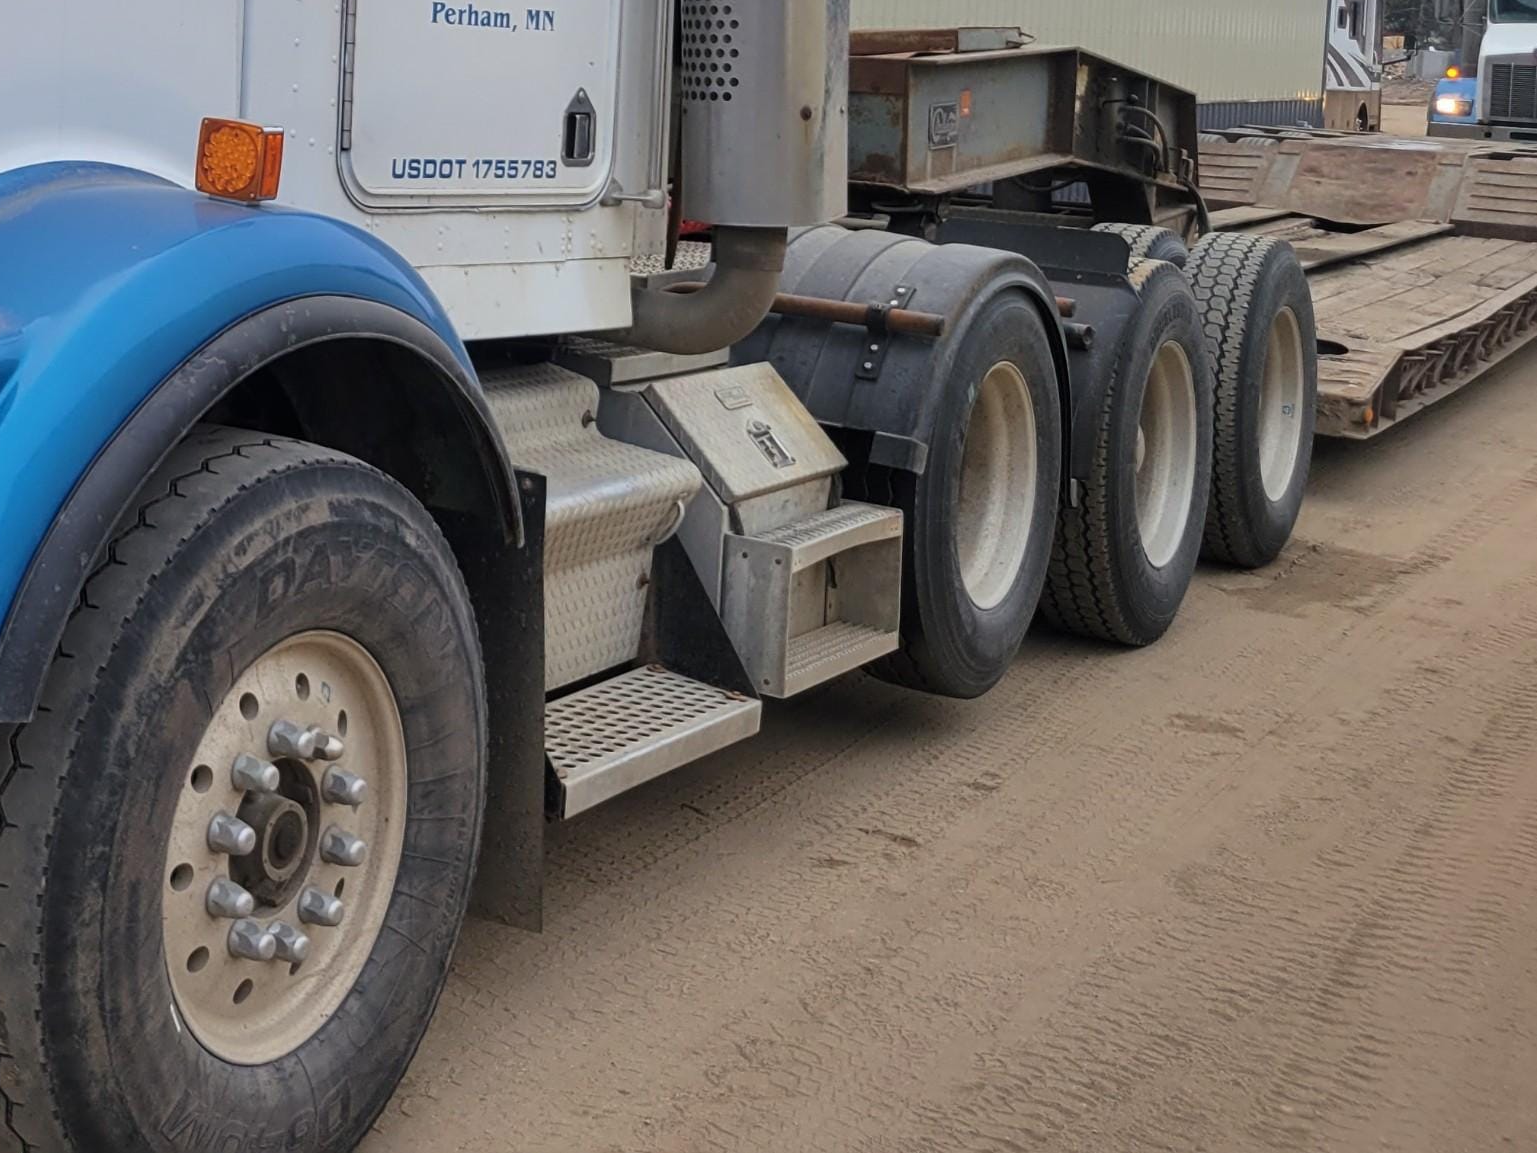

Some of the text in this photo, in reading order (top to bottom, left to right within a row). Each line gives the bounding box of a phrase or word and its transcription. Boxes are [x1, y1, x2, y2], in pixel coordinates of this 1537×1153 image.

[431, 1, 555, 32] Perham, MN
[391, 158, 557, 179] USDOT 1755783
